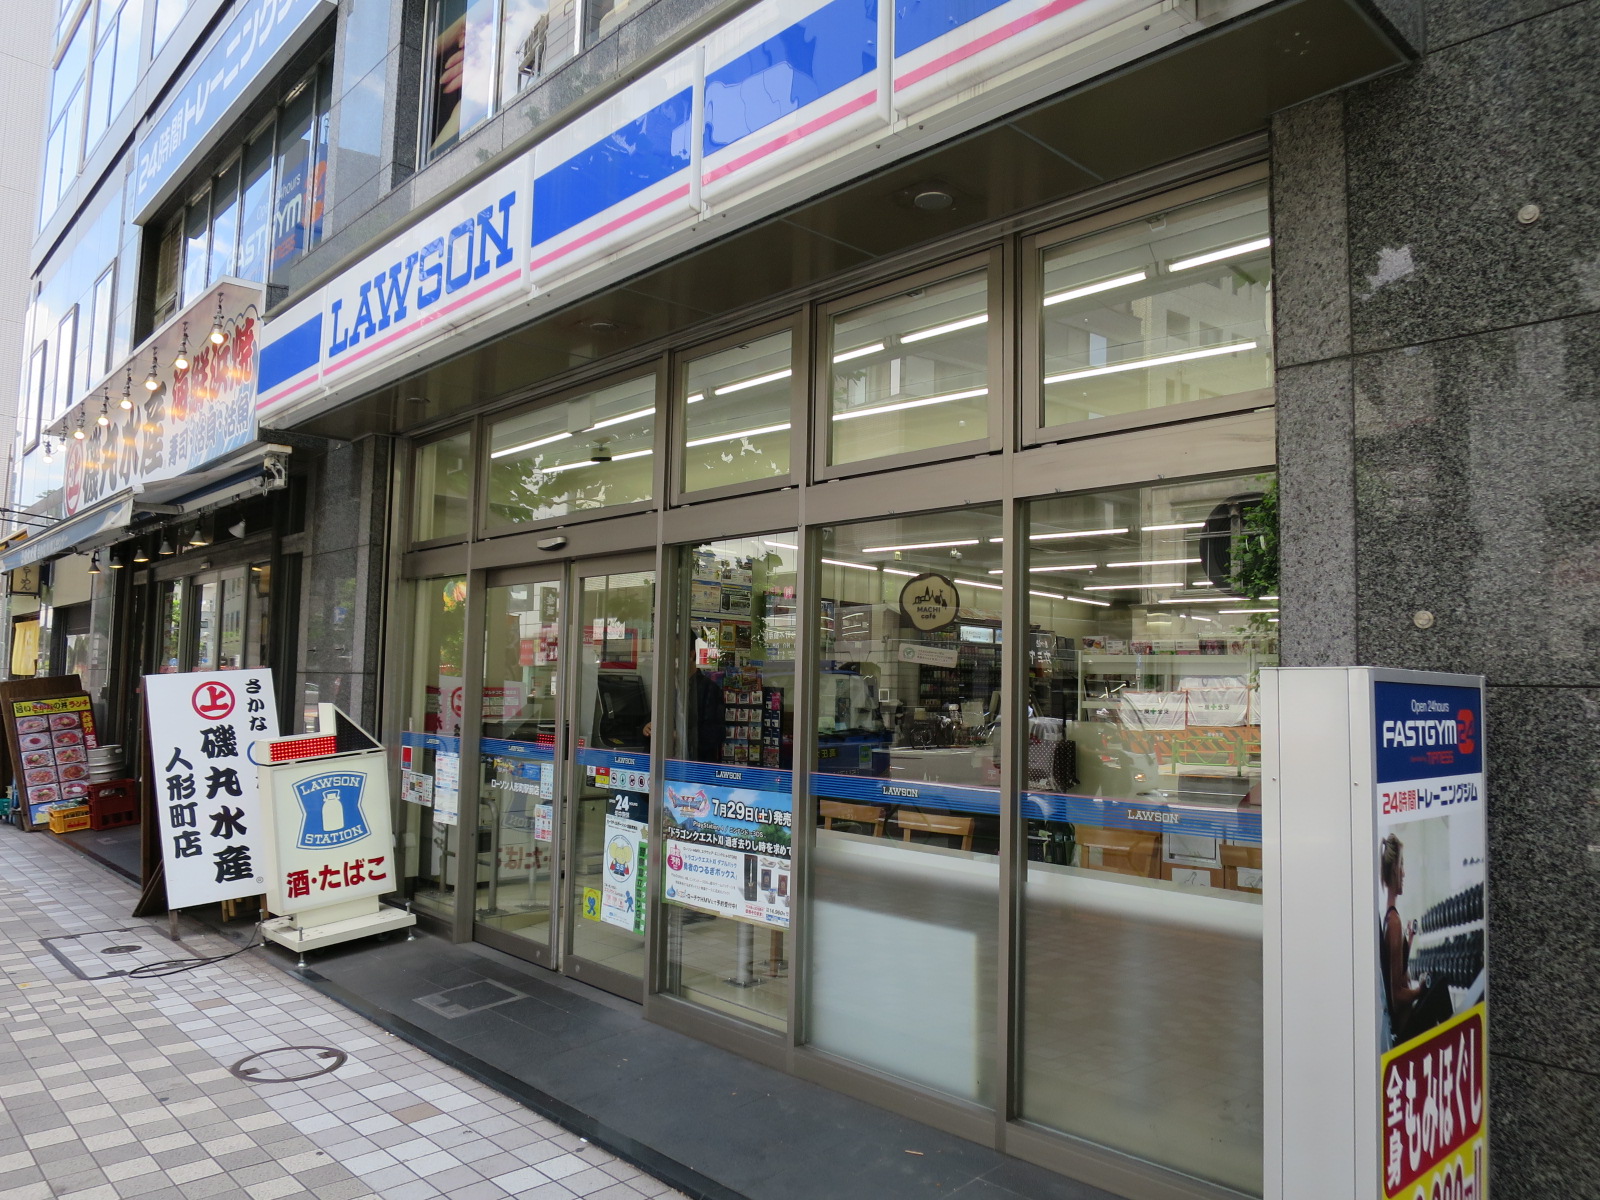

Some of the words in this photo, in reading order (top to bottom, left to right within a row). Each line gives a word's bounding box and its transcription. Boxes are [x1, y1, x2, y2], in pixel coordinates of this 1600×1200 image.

[329, 191, 516, 358] LAWSON
[245, 678, 268, 732] さかな
[1411, 699, 1428, 715] Open
[1383, 719, 1457, 748] FASTGYM
[300, 776, 360, 796] LAWSON
[715, 770, 742, 780] LAWSON
[165, 746, 203, 859] 人形町店
[200, 724, 254, 884] 磯丸水産
[615, 794, 630, 811] 24
[882, 786, 918, 798] LAWSON
[1382, 783, 1478, 815] 24時間トレーニングジム
[1127, 808, 1179, 824] LAWSON
[304, 824, 363, 844] STATION
[286, 856, 387, 898] 酒・たばこ
[1405, 1028, 1482, 1172] もみほぐし
[1386, 1064, 1404, 1190] 全身
